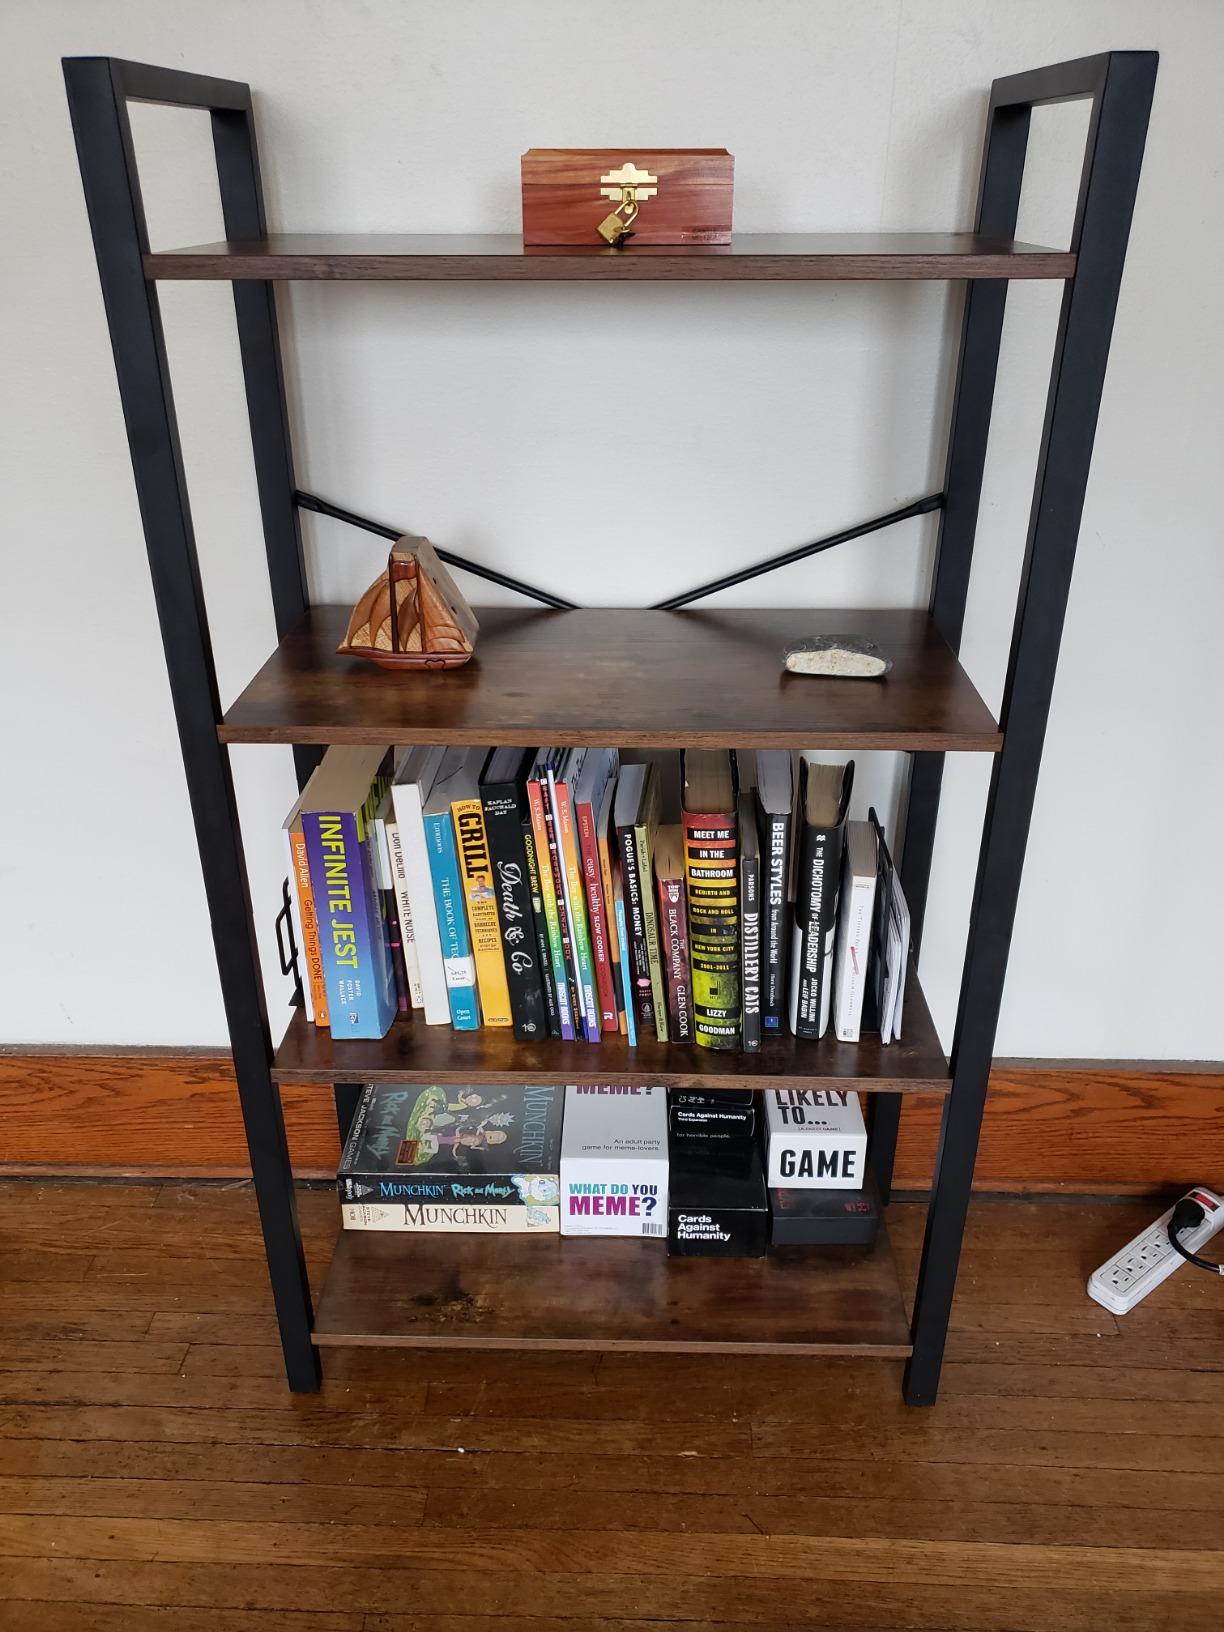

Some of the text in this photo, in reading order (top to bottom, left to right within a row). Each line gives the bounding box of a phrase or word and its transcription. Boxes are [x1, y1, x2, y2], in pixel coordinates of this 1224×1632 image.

[457, 803, 480, 812] HOW TO
[487, 798, 513, 806] KAPLAN
[582, 816, 590, 838] EPSTEIN
[693, 830, 730, 839] MEET ME
[458, 812, 489, 879] GRILL
[624, 833, 634, 871] POGUE'S
[699, 850, 725, 858] IN THE
[295, 843, 309, 888] David Allen
[524, 834, 540, 894] GOODNIGHT BREW
[691, 868, 734, 878] BATHROOM
[769, 822, 785, 905] BEER STYLES
[318, 815, 358, 969] INFINITE JEST
[628, 873, 637, 905] BASICS:
[304, 899, 314, 930] Getting
[401, 891, 415, 943] WHITE NOISE
[444, 898, 455, 926] BOOK
[496, 860, 533, 975] Death & Co
[586, 858, 605, 962] easy healthy SLOW COOKER
[632, 907, 643, 937] MONEY
[720, 907, 734, 915] ROLL
[805, 846, 825, 973] THE DICHOTOMY OF LEADERSHIP
[308, 931, 318, 956] Things
[448, 927, 458, 940] OF
[645, 912, 658, 965] DINOSAUR TIME
[668, 909, 682, 980] BLACK COMPANY
[769, 909, 779, 964] from Around the World
[694, 943, 706, 951] NEW
[707, 944, 721, 952] YORK
[312, 956, 322, 981] DONE
[743, 912, 760, 1014] DISTILLERY CATS
[456, 1009, 470, 1017] Open
[676, 985, 689, 1037] GLEN COOK
[706, 1008, 727, 1018] LIZZY
[800, 1000, 808, 1019] BABIN
[808, 977, 818, 1023] JOCKO WILLINK
[698, 1024, 736, 1035] GOODMAN
[775, 1089, 848, 1107] LIKELY
[352, 1105, 367, 1141] JACKSON
[514, 1086, 555, 1164] MUNCHKIN
[719, 1113, 747, 1121] Humanity
[777, 1105, 828, 1125] TO...
[343, 1142, 357, 1170] GAMES
[780, 1149, 857, 1178] GAME
[379, 1182, 444, 1198] MUNCHKIN
[450, 1183, 474, 1198] Rick
[484, 1183, 515, 1198] Morty
[569, 1183, 658, 1196] WHAT DO YOU
[403, 1203, 507, 1229] MUNCHKIN
[569, 1195, 657, 1217] MEME?
[677, 1214, 712, 1224] Cards
[677, 1223, 720, 1232] Against
[677, 1231, 731, 1242] Humanity
